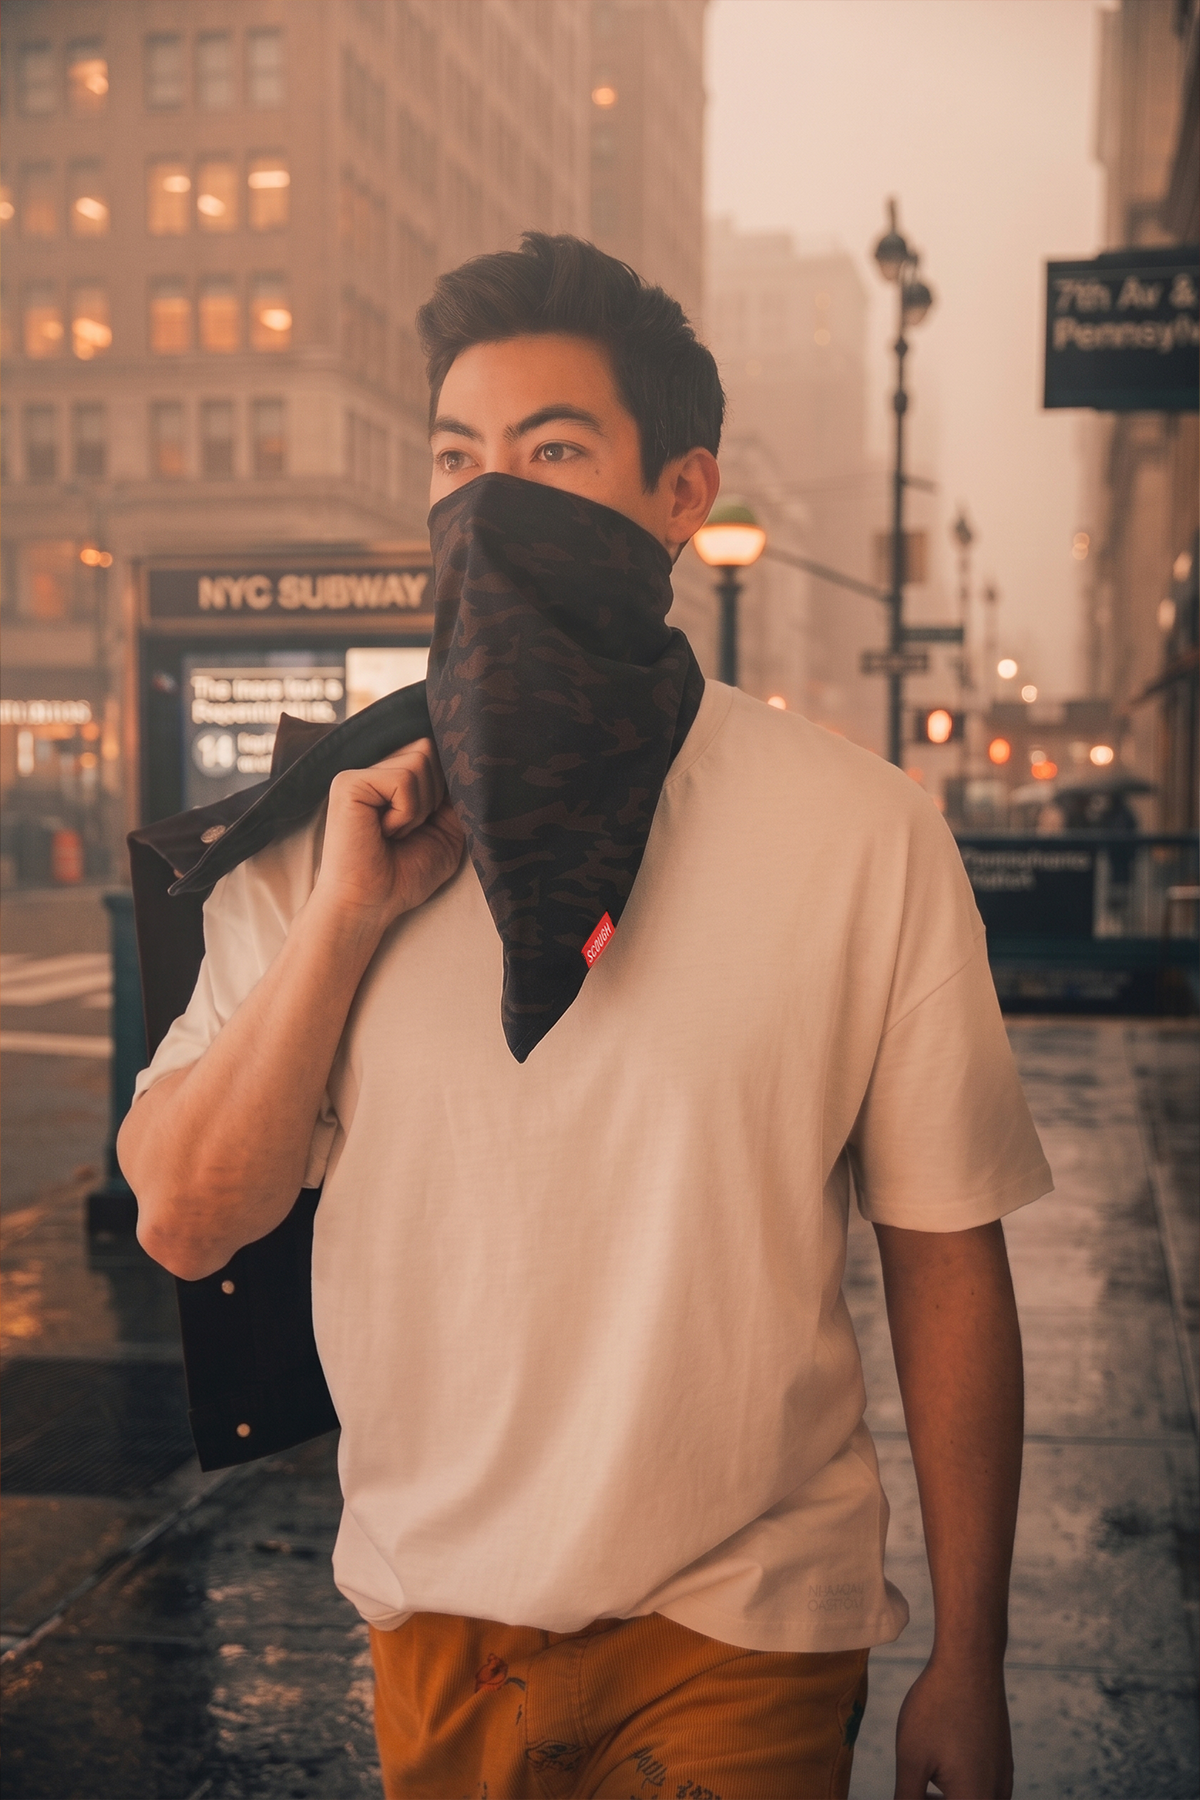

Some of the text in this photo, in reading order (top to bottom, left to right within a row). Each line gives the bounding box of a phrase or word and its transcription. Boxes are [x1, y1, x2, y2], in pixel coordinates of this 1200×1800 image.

[1055, 272, 1197, 314] 7th Av &
[198, 572, 428, 610] NYC SUBWAY
[586, 922, 612, 963] SCOUGH
